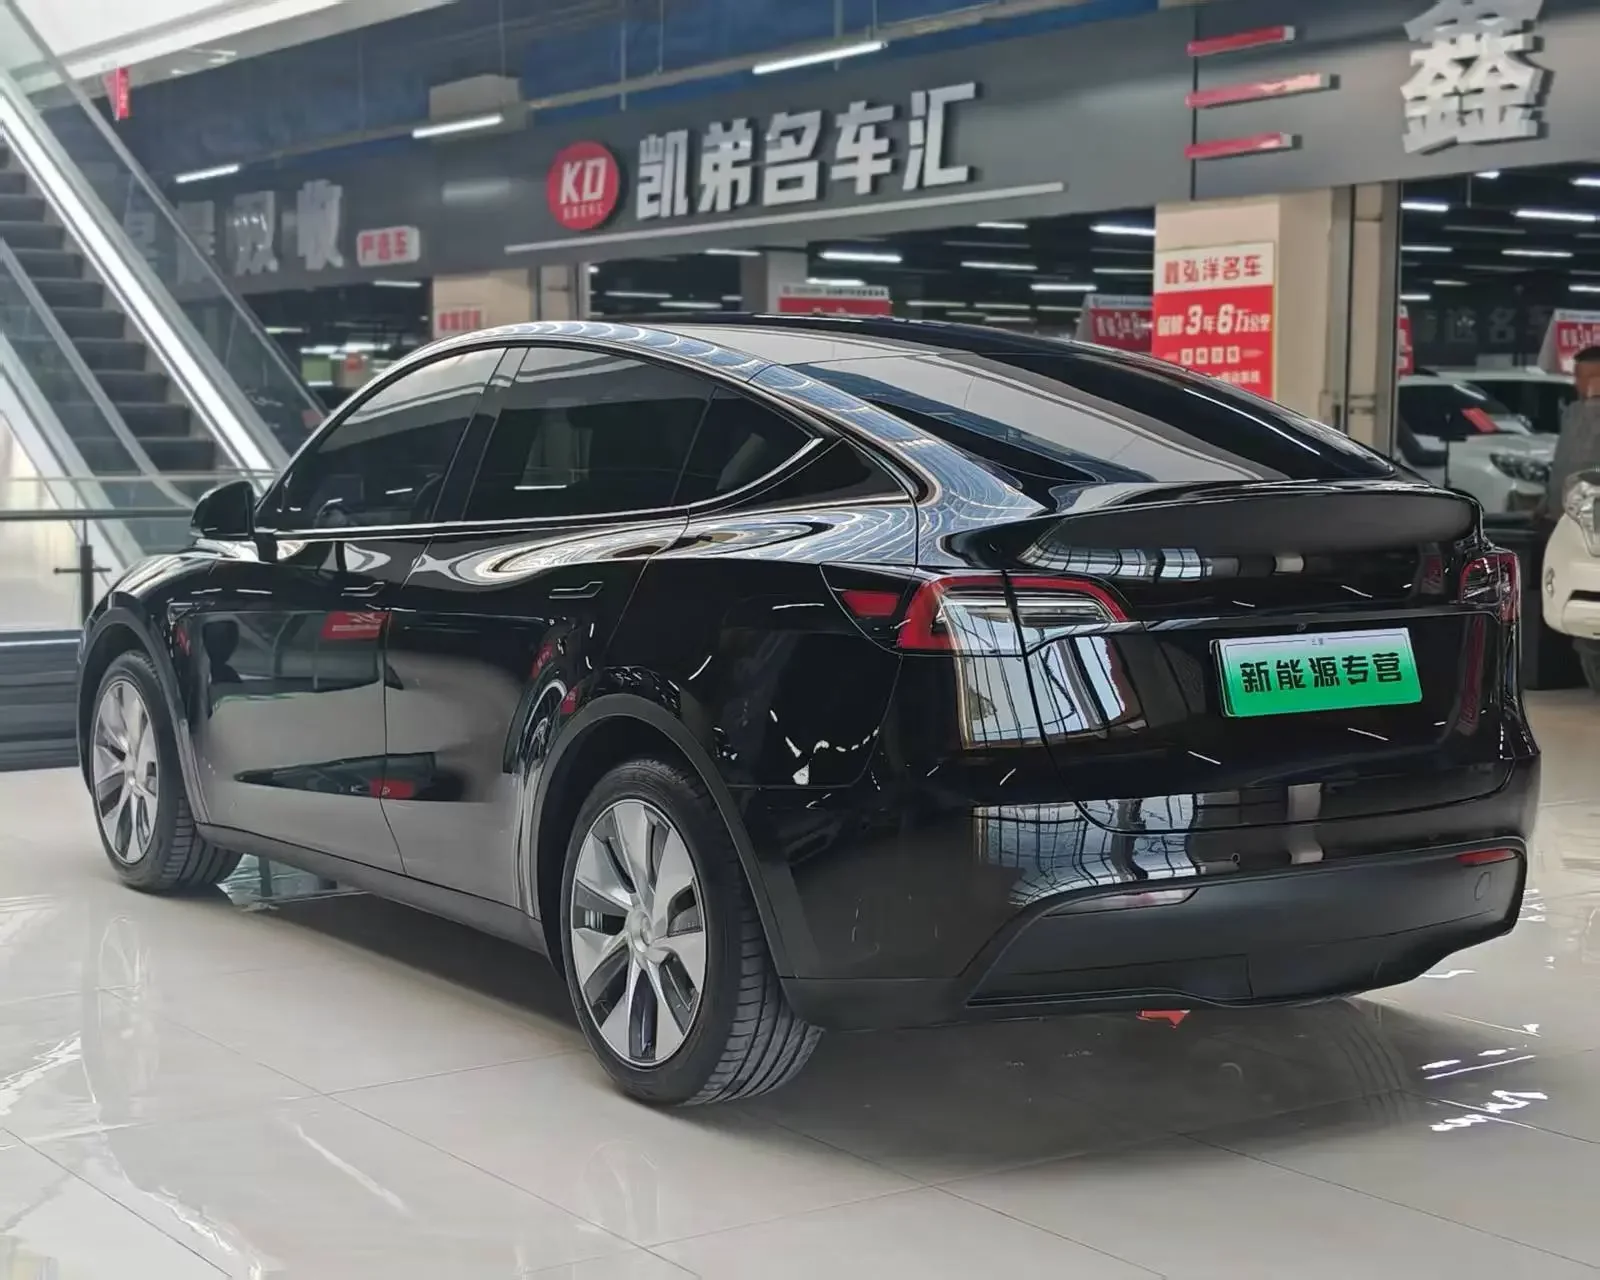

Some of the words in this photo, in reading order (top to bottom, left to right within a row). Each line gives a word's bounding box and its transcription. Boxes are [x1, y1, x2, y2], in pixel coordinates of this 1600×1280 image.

[636, 82, 976, 220] 凯弟名车汇
[560, 158, 607, 205] KD
[1239, 652, 1404, 693] 新能源专营
